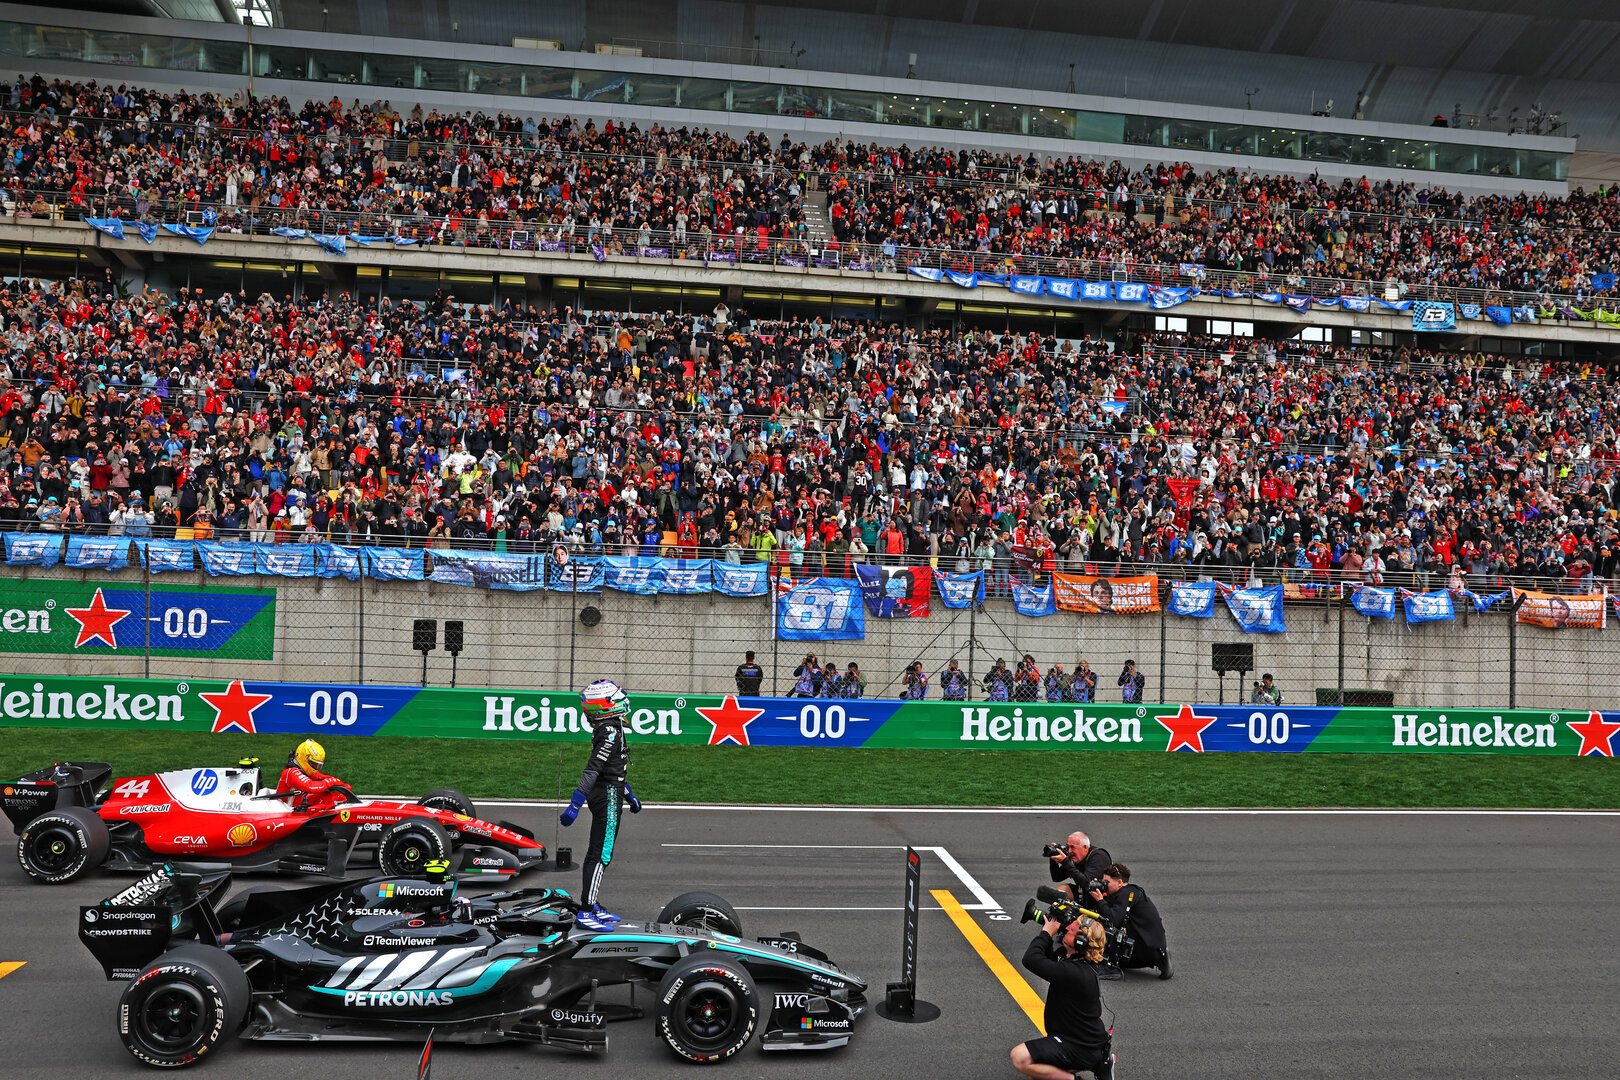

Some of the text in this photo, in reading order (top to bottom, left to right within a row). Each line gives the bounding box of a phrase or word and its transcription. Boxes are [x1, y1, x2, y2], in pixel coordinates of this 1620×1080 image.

[1085, 282, 1106, 297] 81
[1120, 284, 1143, 299] 81
[1422, 308, 1446, 322] 63
[855, 475, 867, 486] 30
[722, 570, 758, 593] 63
[784, 586, 852, 630] 81
[1176, 588, 1210, 612] 81
[1357, 587, 1392, 611] 81
[1413, 596, 1449, 616] 81
[164, 607, 208, 638] 0.0
[0, 683, 185, 722] eineken
[309, 690, 358, 726] 0.0
[800, 704, 846, 738] 0.0
[960, 707, 1144, 743] Heineken
[1248, 712, 1289, 744] 0.0
[1392, 714, 1557, 748] Heineken
[13, 788, 49, 797] V-Power
[114, 779, 151, 799] 44
[222, 802, 243, 811] IBM
[396, 886, 444, 897] Microsoft
[102, 911, 156, 921] Snapdragon
[355, 908, 394, 916] SOLERA
[89, 928, 152, 936] CROWDSTRIKE
[375, 936, 437, 946] TeamViewer
[811, 974, 845, 988] Einhell
[344, 991, 454, 1007] PETRONAS
[663, 977, 684, 1005] PIRELLI
[814, 1019, 849, 1028] Microsoft
